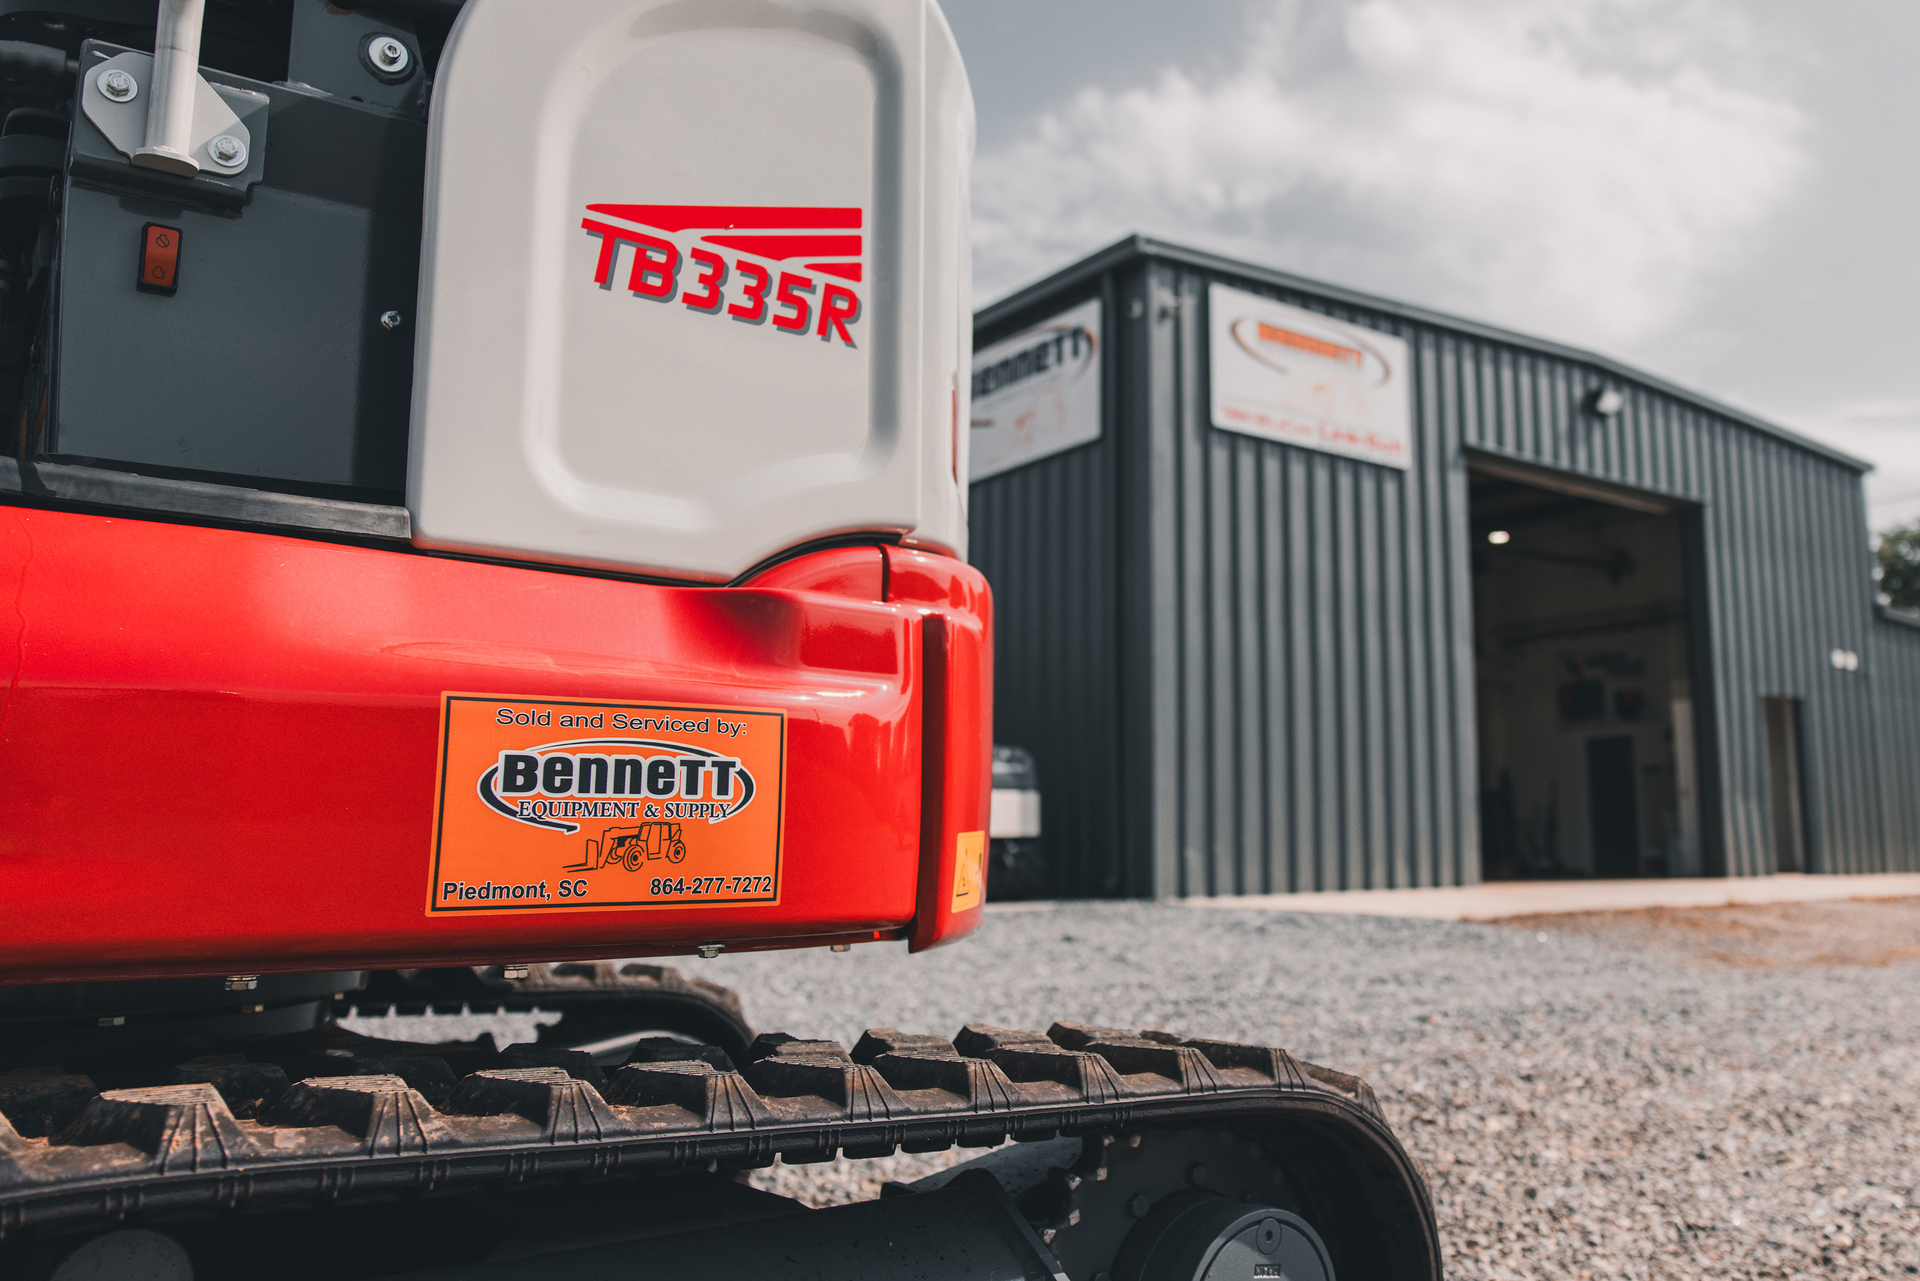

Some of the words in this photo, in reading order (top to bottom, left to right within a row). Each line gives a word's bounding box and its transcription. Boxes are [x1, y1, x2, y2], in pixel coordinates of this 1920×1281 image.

[581, 217, 862, 349] TB335R
[496, 708, 551, 727] Sold
[559, 711, 603, 729] and
[612, 713, 710, 734] Serviced
[717, 717, 748, 738] by:
[517, 800, 640, 819] EQUIPMENT
[644, 803, 661, 819] &
[663, 802, 731, 820] SUPPLY
[442, 881, 551, 901] Piedmont,
[558, 879, 589, 898] SC
[650, 875, 773, 896] 864-277-7272
